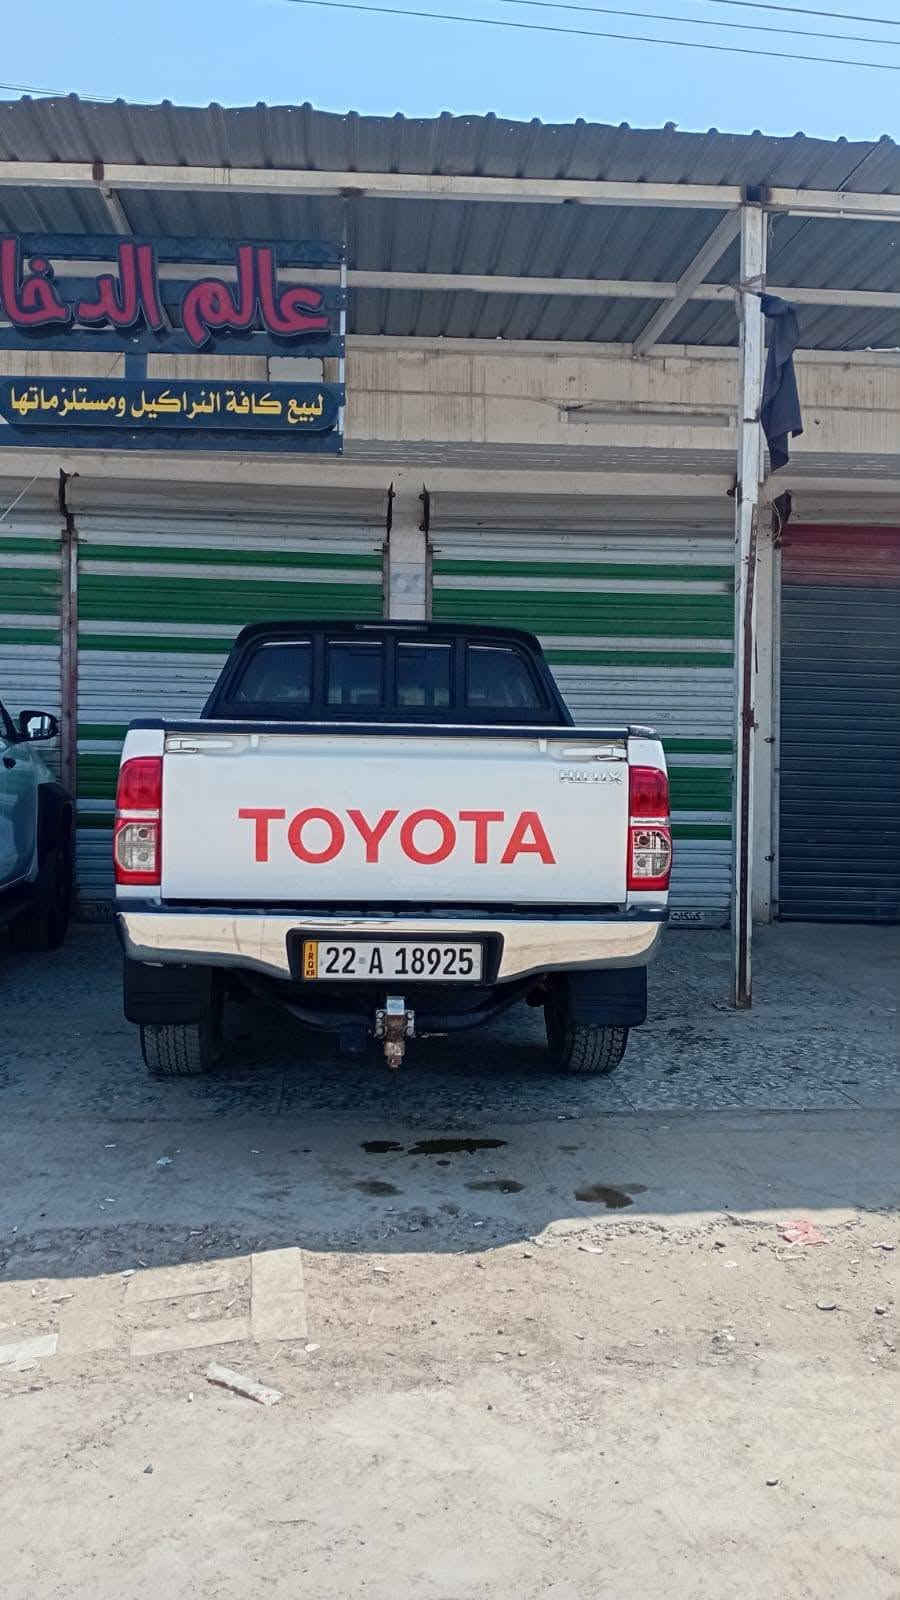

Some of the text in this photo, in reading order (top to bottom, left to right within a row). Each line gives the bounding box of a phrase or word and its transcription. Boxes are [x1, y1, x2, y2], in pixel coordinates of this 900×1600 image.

[183, 245, 330, 346] عالم
[11, 386, 323, 424] لبيع كافة النراكيل ومستلزماتها
[238, 807, 557, 865] TOYOTA
[325, 947, 474, 975] 22 A 18925
